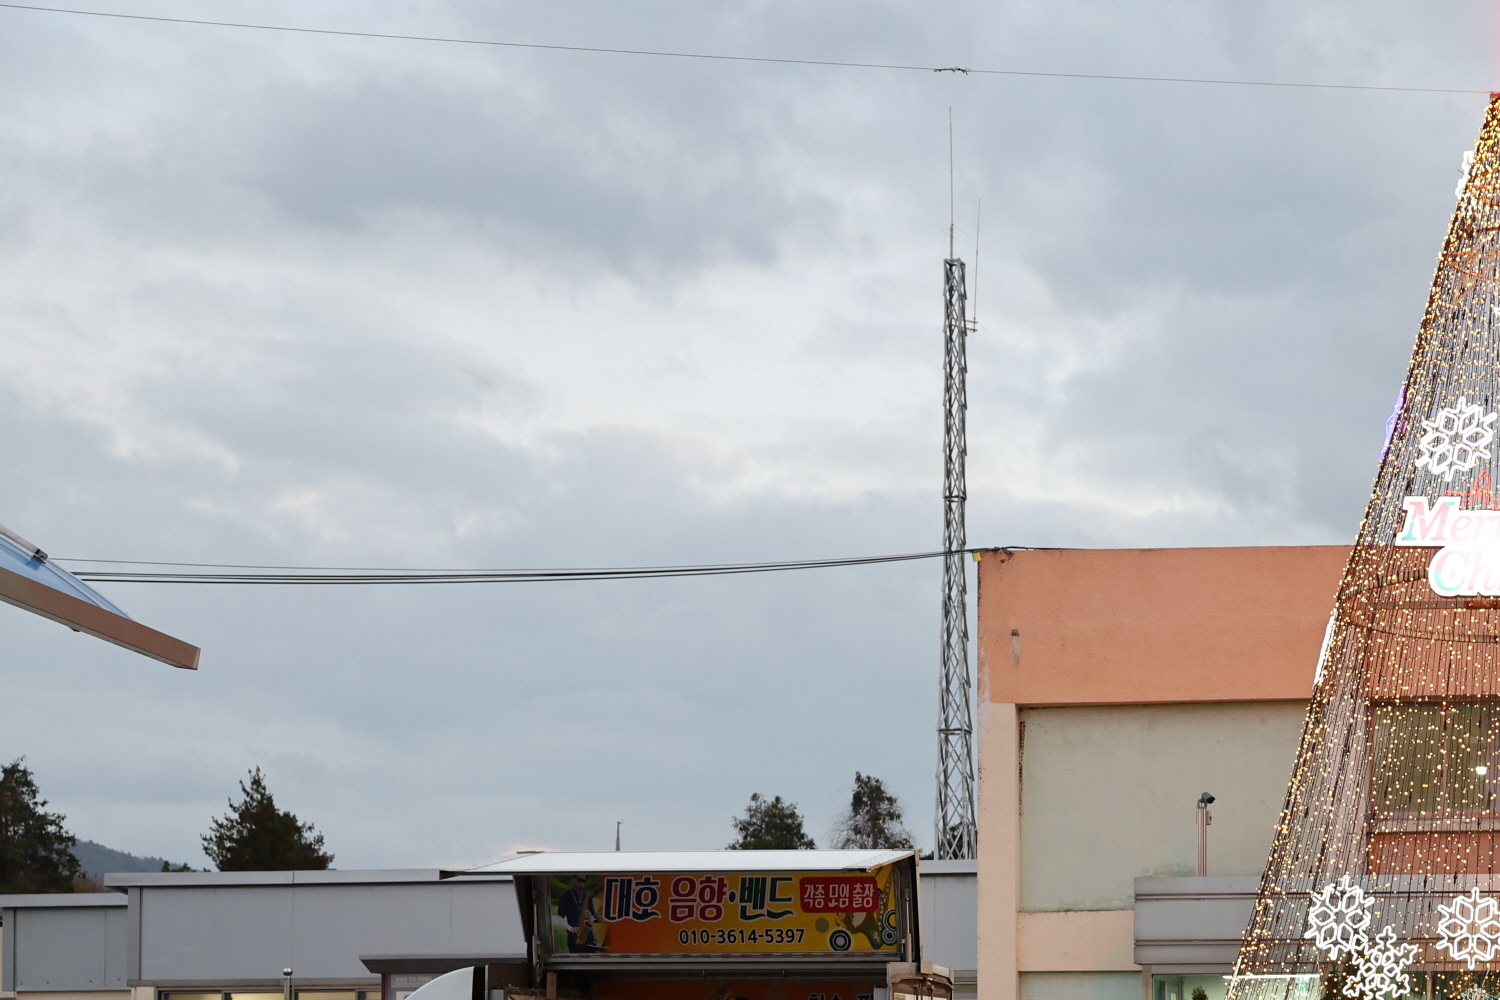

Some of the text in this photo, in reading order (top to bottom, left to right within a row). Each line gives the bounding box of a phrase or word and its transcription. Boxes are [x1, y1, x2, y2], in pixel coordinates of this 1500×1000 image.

[604, 877, 661, 923] 대호
[804, 884, 826, 909] 각종
[829, 883, 849, 909] 모임
[853, 883, 875, 908] 출장
[678, 928, 805, 945] 010-3614-5397
